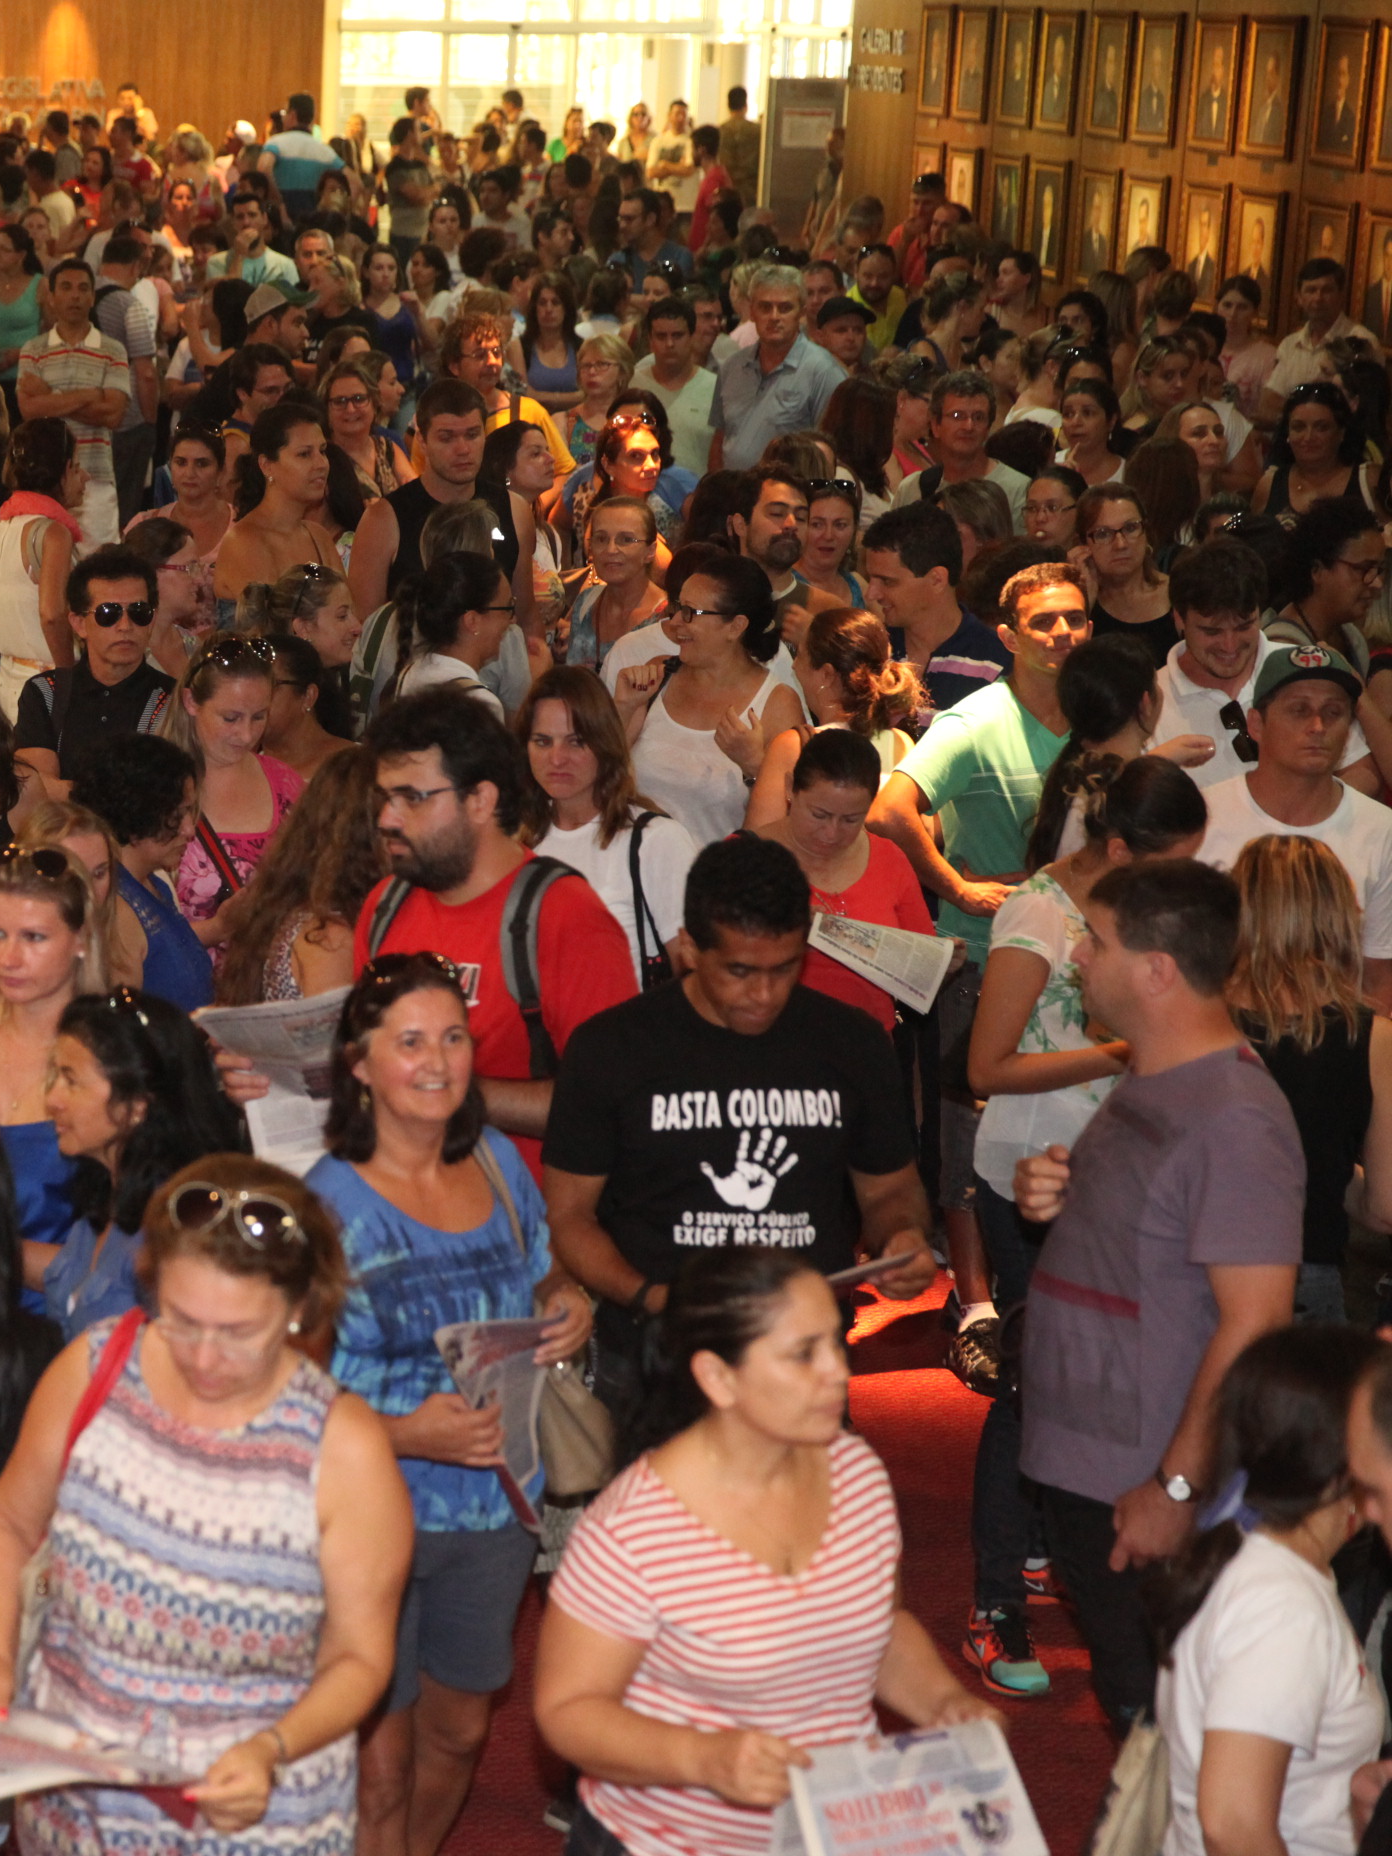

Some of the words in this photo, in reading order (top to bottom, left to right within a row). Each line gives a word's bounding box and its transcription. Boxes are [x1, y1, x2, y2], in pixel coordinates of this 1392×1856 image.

[860, 28, 890, 54] GALERIA
[892, 29, 904, 56] DE
[651, 1090, 722, 1131] BASTA
[727, 1088, 842, 1128] COLOMBO!
[681, 1210, 694, 1225] O
[696, 1211, 755, 1229] SERVIÇO
[759, 1209, 810, 1228] PÚBLICO
[673, 1224, 728, 1247] EXIGE
[733, 1225, 816, 1247] RESPEITO
